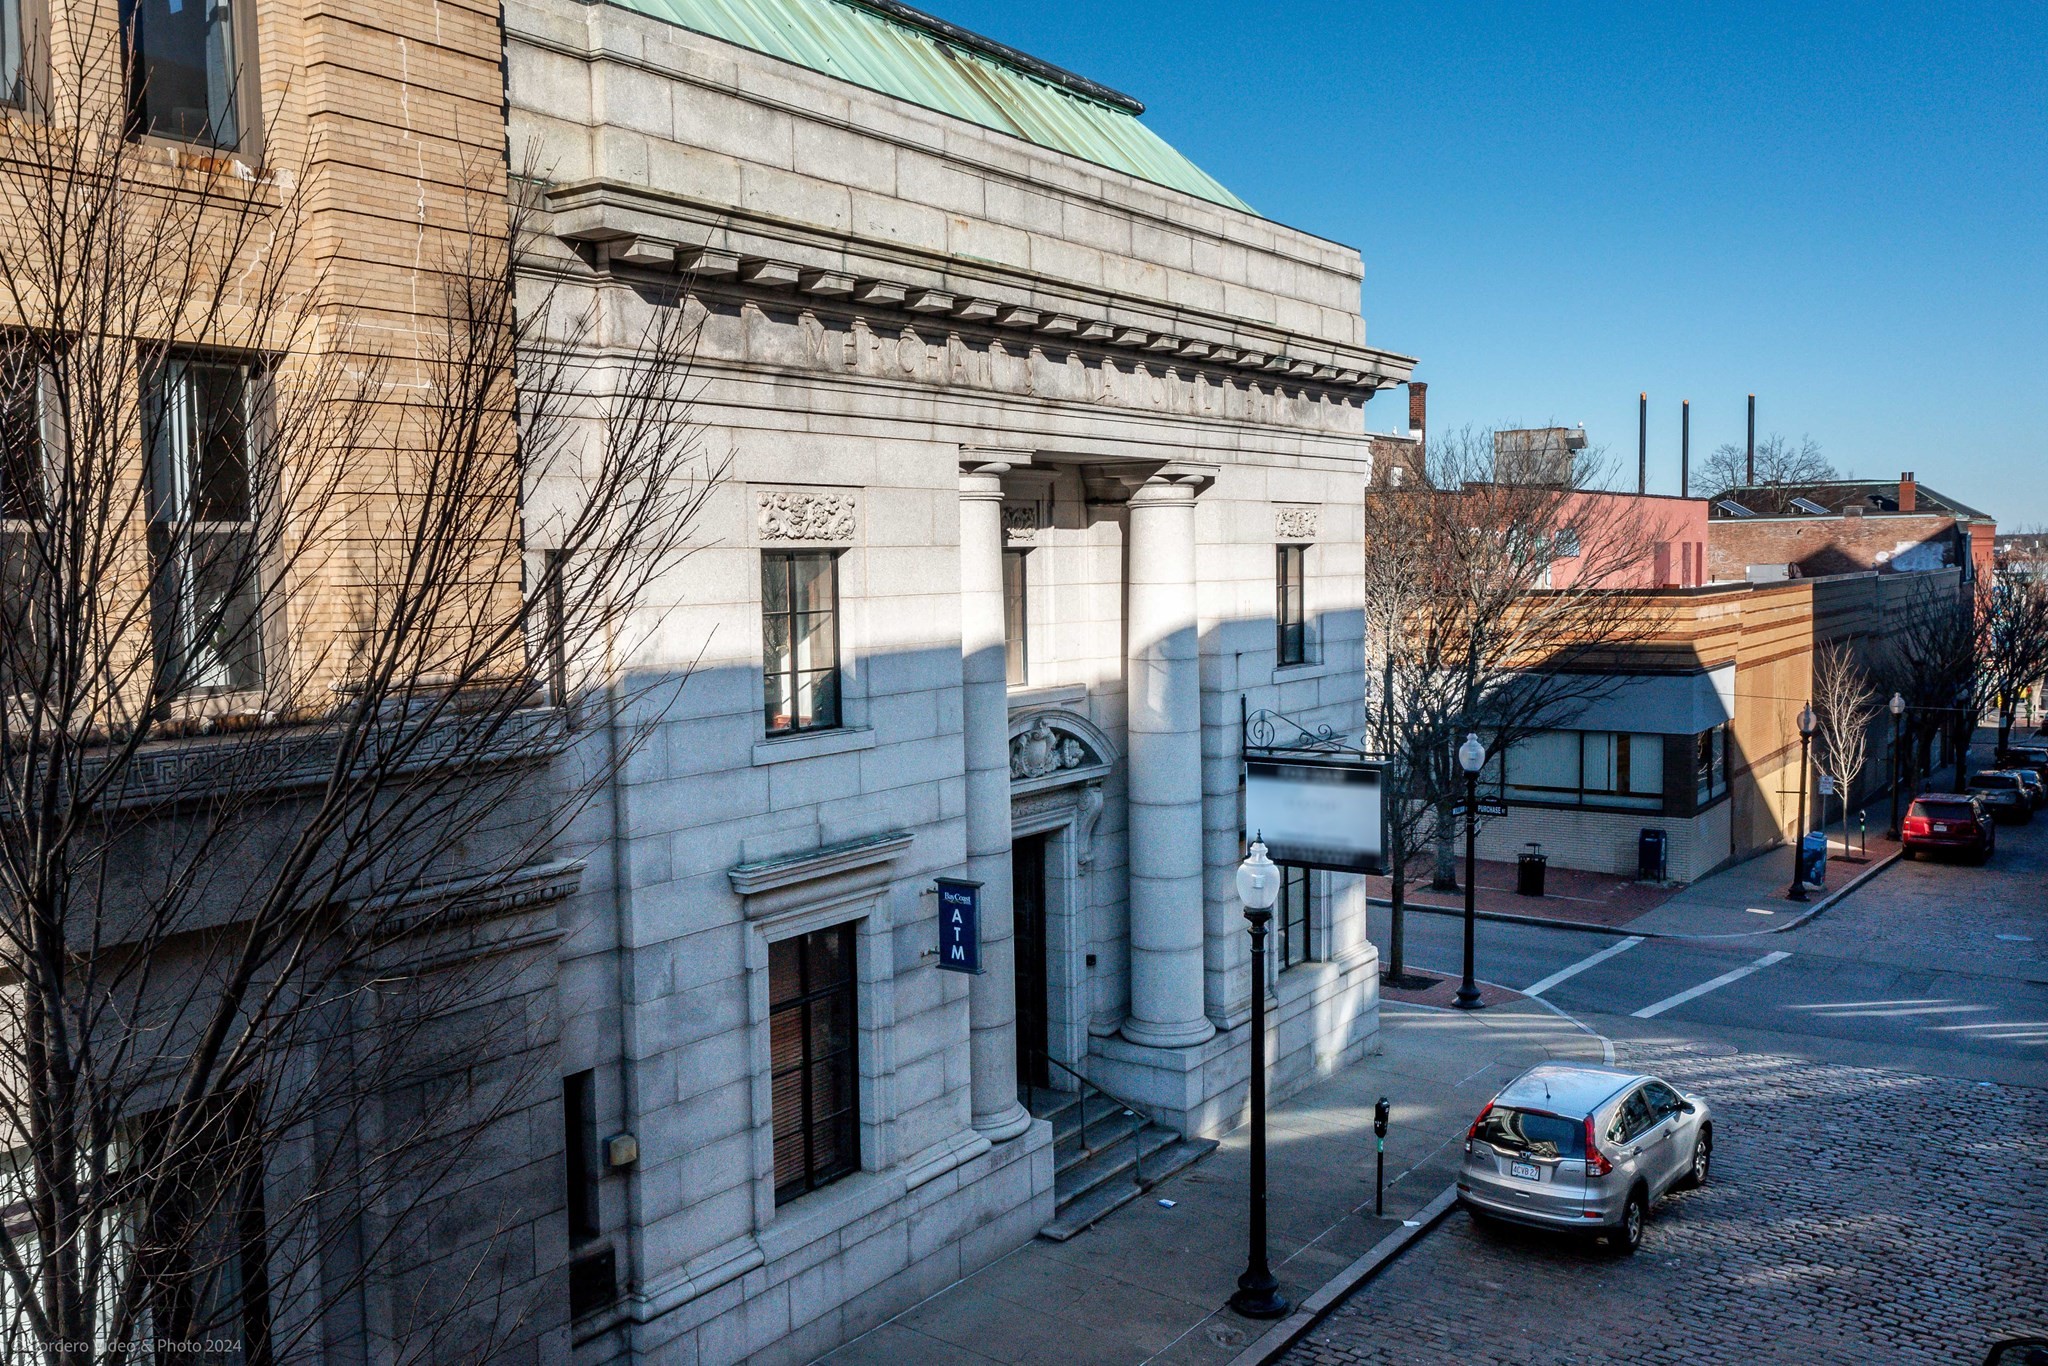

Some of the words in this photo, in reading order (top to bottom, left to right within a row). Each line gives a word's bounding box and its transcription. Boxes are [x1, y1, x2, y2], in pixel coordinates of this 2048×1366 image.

[804, 321, 1034, 397] MERCHANTS
[944, 891, 971, 902] BayCoast
[951, 908, 965, 961] ATM
